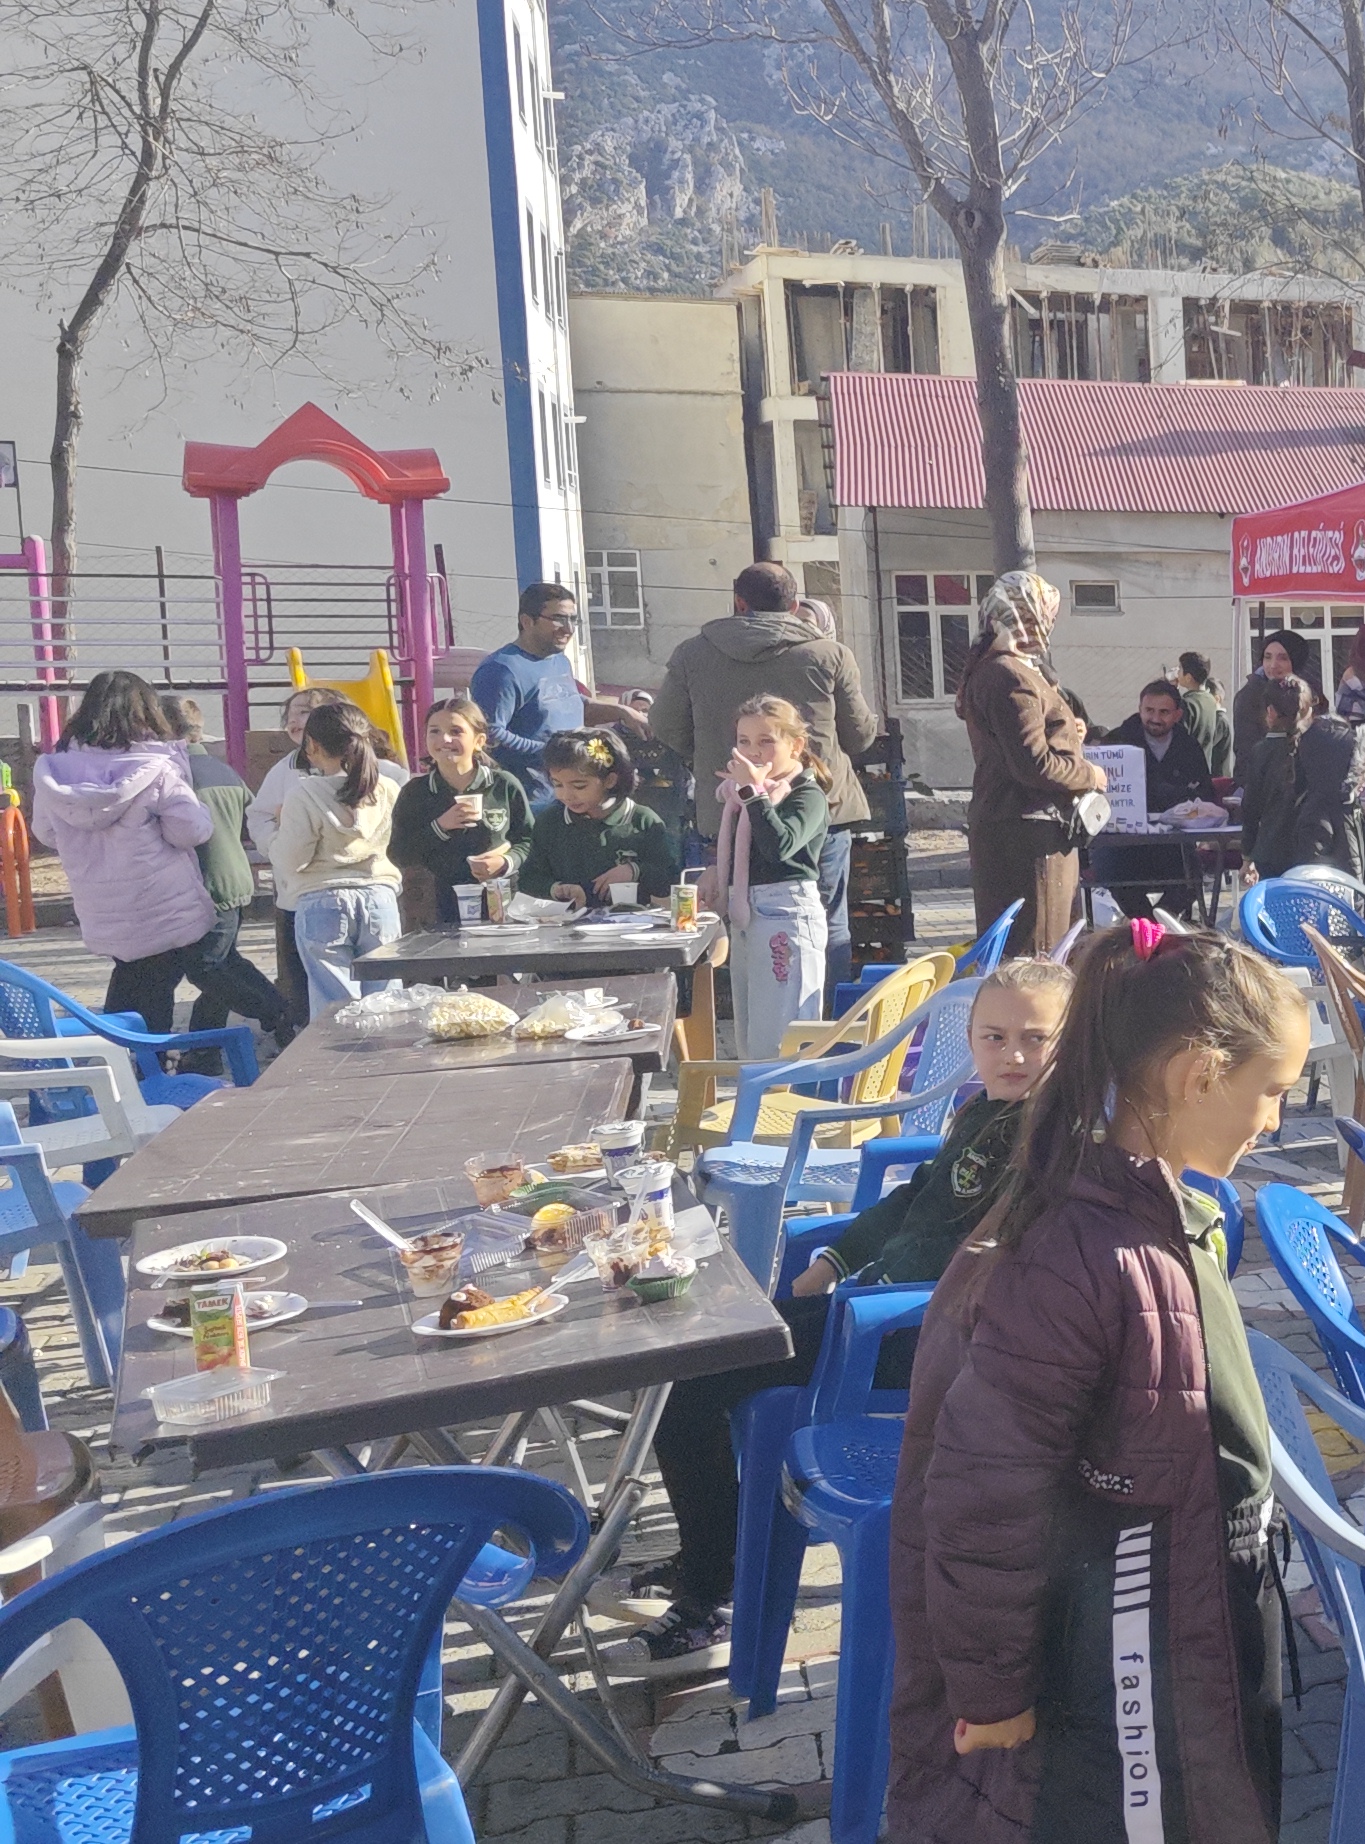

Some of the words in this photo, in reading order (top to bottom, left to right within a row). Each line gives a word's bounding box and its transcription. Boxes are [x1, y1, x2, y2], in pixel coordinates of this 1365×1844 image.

[1255, 532, 1291, 579] ANDIRIN
[1101, 749, 1124, 760] TÜMÜ
[197, 1297, 229, 1309] TAMEK
[1119, 1651, 1149, 1808] fashion
